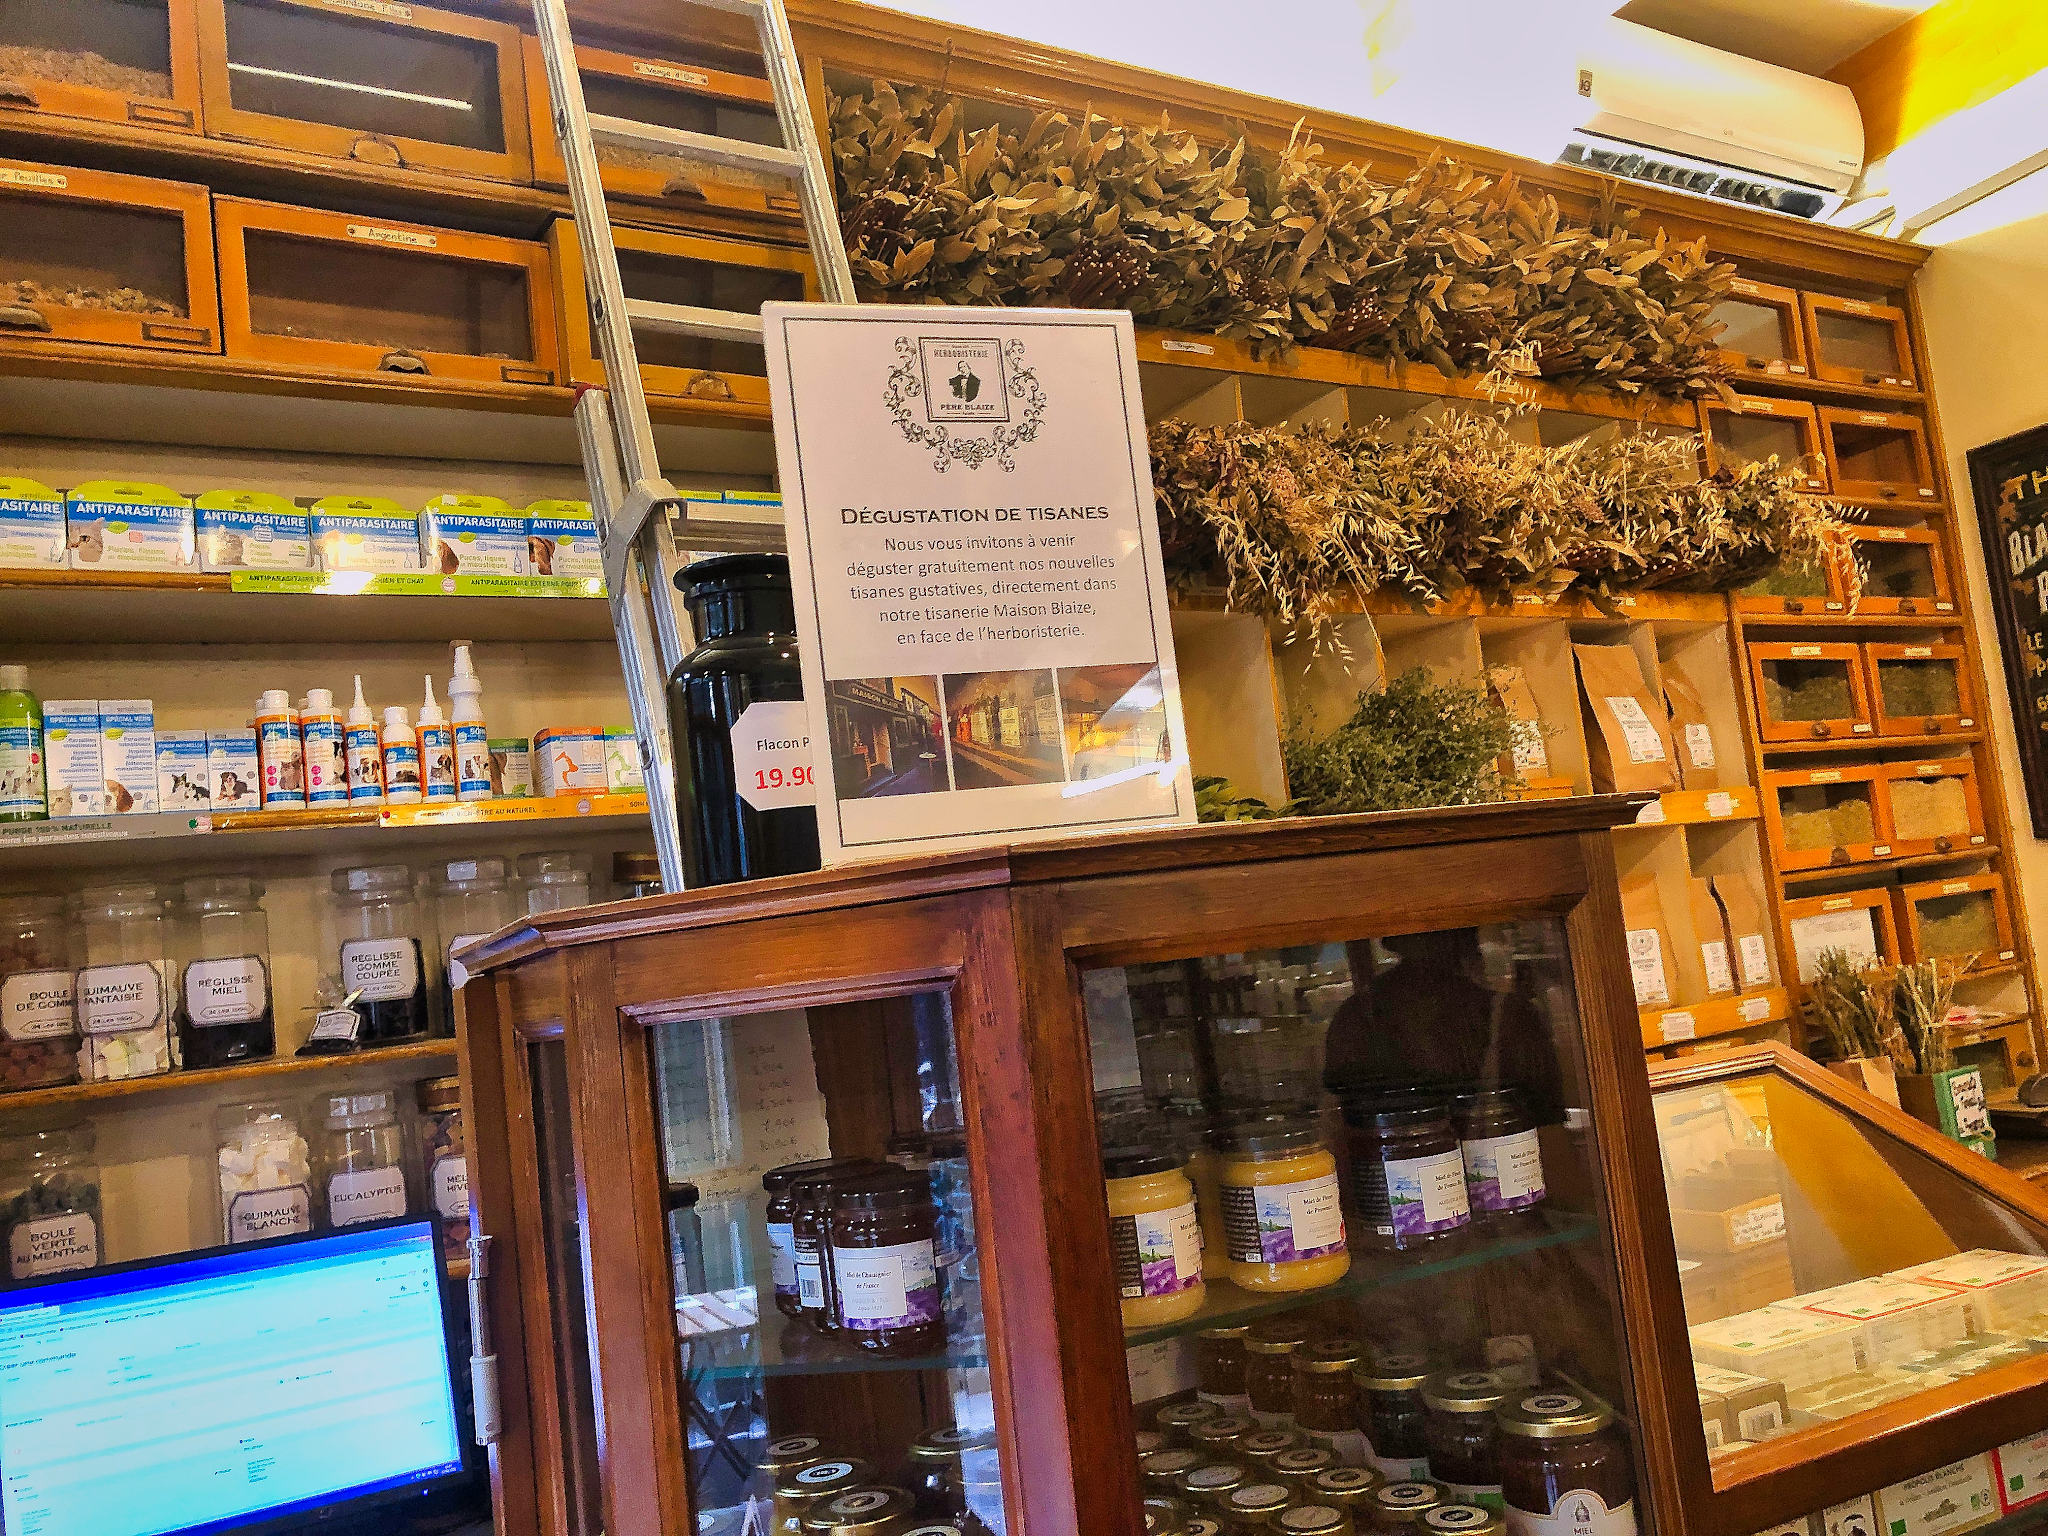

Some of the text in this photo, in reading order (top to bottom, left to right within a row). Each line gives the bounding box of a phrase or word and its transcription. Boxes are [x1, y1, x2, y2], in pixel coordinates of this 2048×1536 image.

[368, 228, 418, 244] Argentine
[76, 502, 194, 519] ANTIPARASITAIRE
[841, 506, 1109, 524] DÉGUSTATION DE TISANES
[203, 510, 307, 528] ANTIPARASITAIRE
[318, 517, 415, 531] ANTIPARASITAIRE
[433, 515, 524, 529] ANTIPARASITAIRE
[885, 533, 1076, 551] Nous vous invitons à venir
[846, 555, 1115, 579] déguster gratuitement nos nouvelles
[471, 579, 528, 587] ANTIPARASITAIRE
[850, 577, 1117, 601] tisanes gustatives, directement dans
[879, 601, 1097, 622] notre tisanerie Maison Blaize,
[897, 623, 1086, 644] en face de l’herboristerie.
[756, 738, 800, 751] Flacon
[506, 805, 537, 815] NATUREL
[351, 950, 403, 963] RÉGLISSE
[357, 960, 399, 972] GOMME
[198, 974, 255, 988] RÉGLISSE
[356, 968, 401, 981] COUPÉE
[29, 989, 69, 1001] BOULE
[212, 986, 242, 996] MIEL
[16, 1002, 35, 1012] DE
[334, 1184, 402, 1203] EUCALYPTUS
[246, 1215, 300, 1231] BLANCHE
[30, 1226, 76, 1242] BOULE
[31, 1236, 77, 1252] VERTE
[16, 1243, 92, 1264] AU MENTHOL
[1573, 1526, 1594, 1536] MIEL
